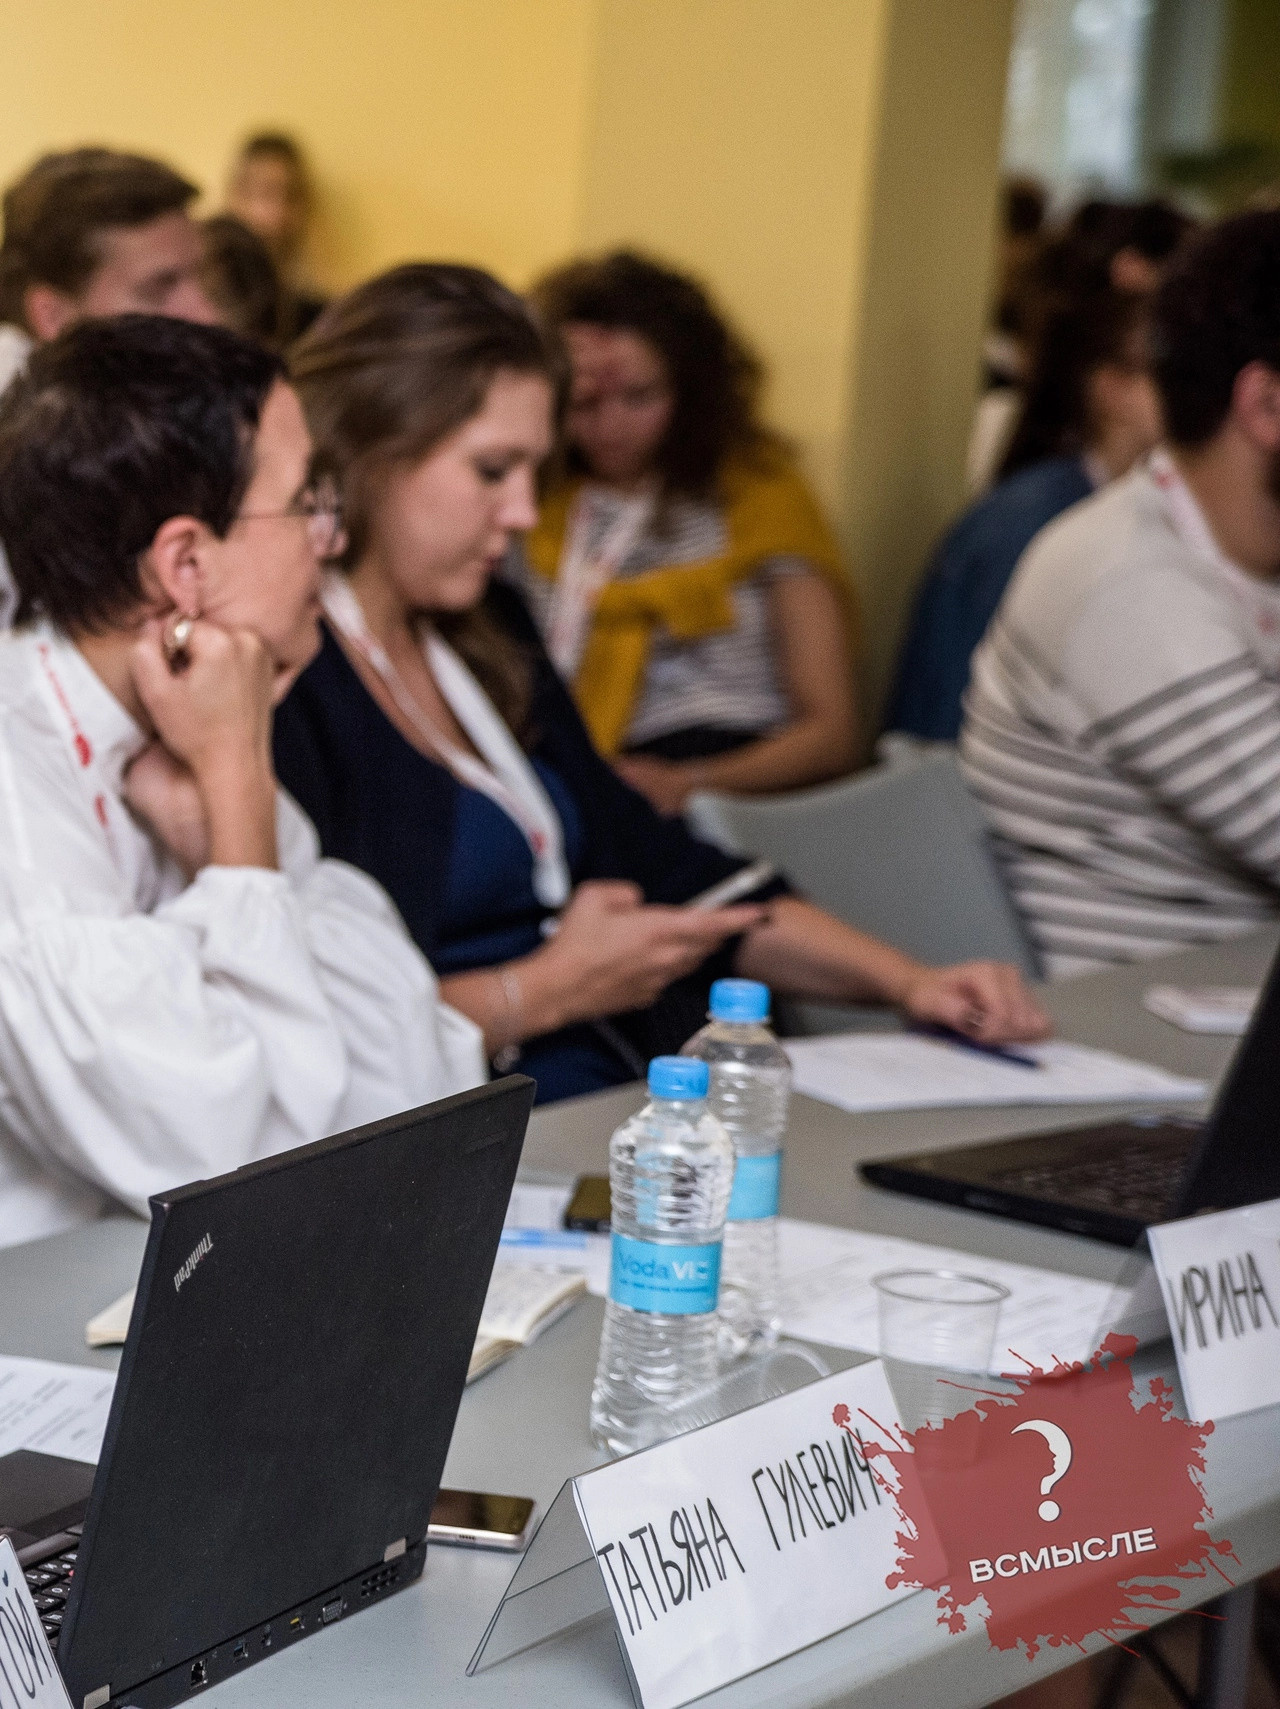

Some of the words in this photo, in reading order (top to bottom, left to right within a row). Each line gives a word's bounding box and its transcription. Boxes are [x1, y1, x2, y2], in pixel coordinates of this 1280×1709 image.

[174, 1232, 213, 1293] ThinkPad
[1166, 1252, 1279, 1353] ИРИНА
[596, 1497, 746, 1636] ТАТЬЯНА
[750, 1427, 881, 1551] ГУЛЕВИЧ
